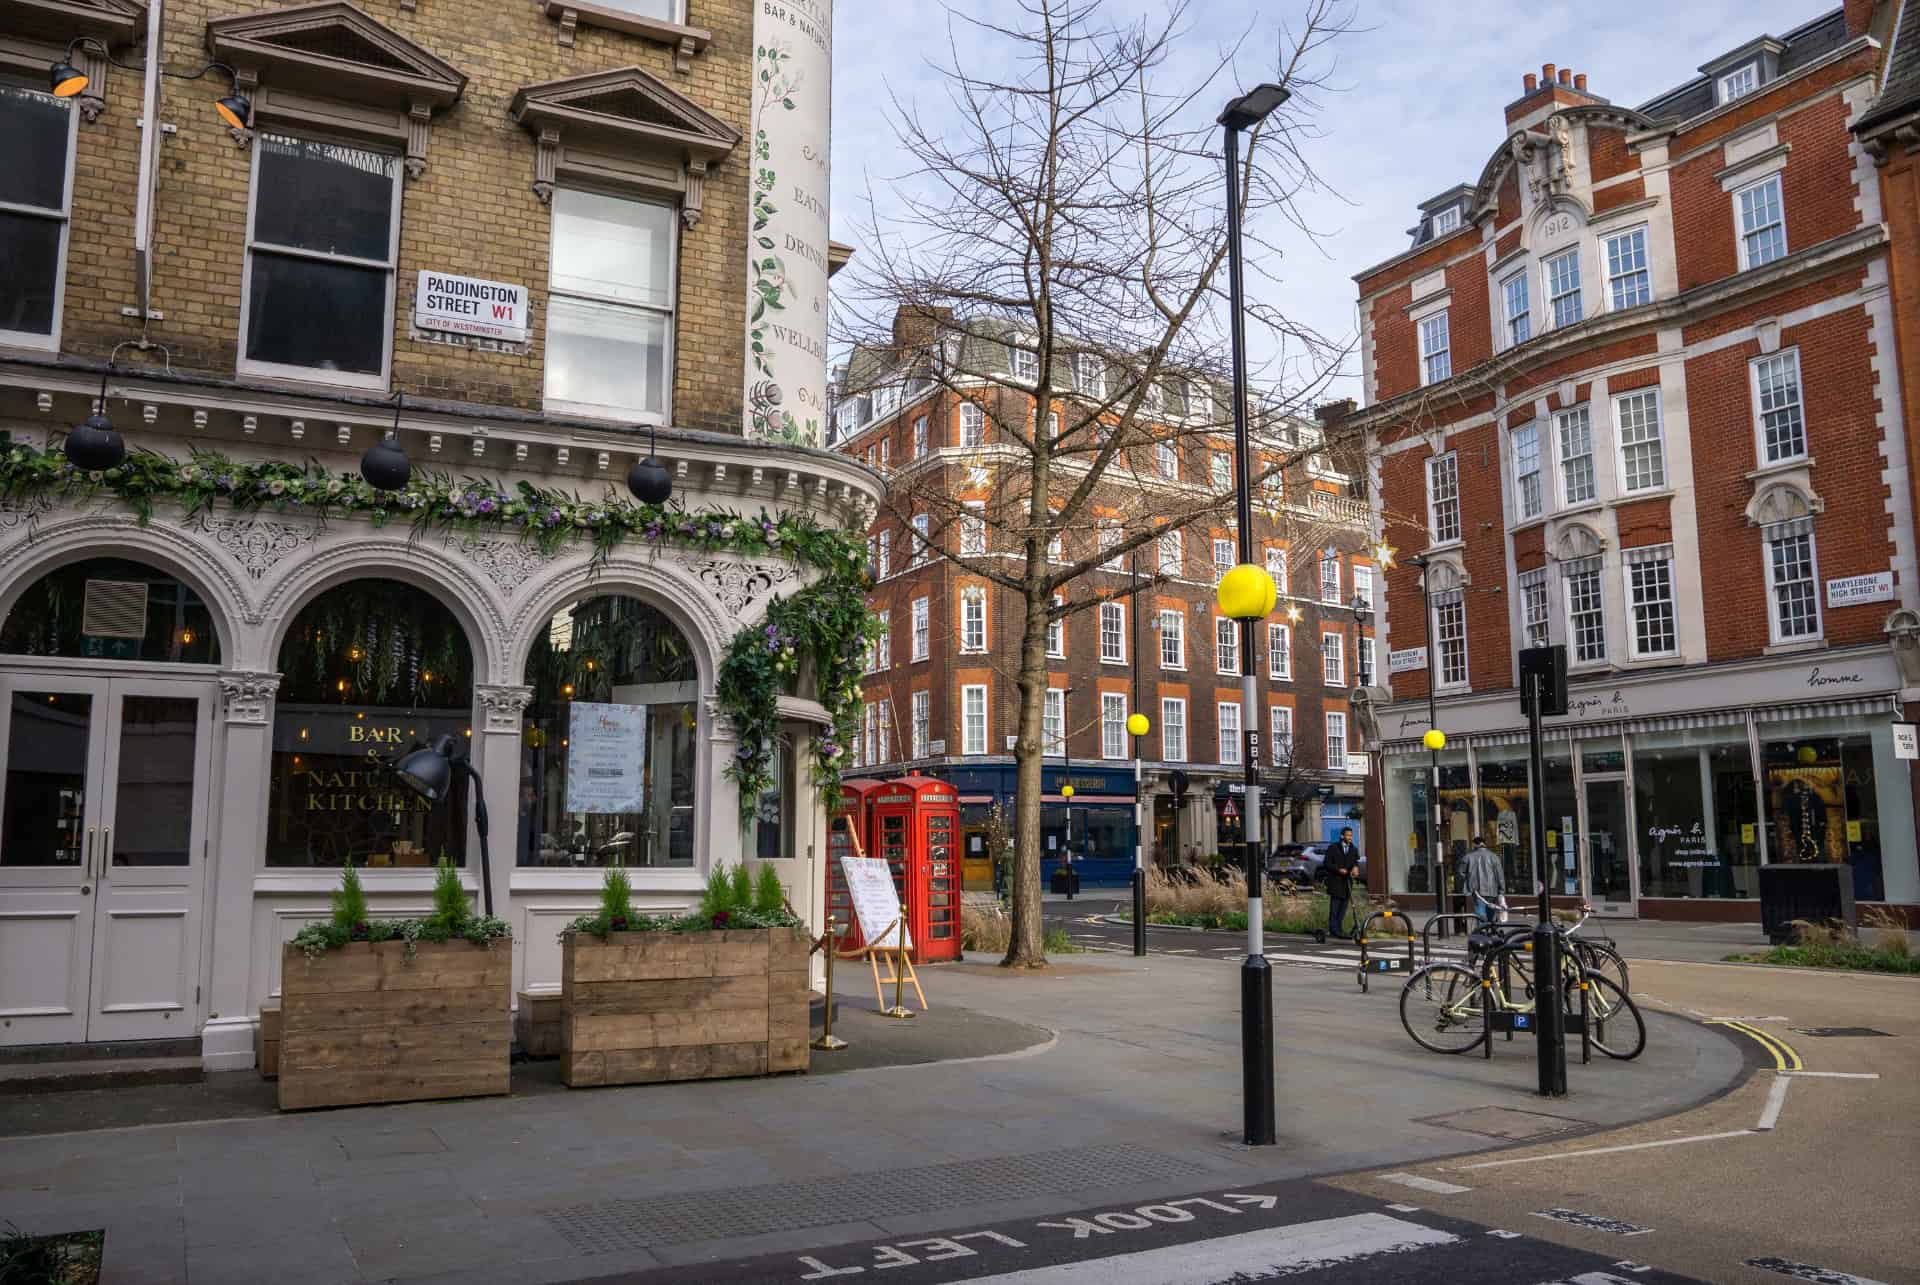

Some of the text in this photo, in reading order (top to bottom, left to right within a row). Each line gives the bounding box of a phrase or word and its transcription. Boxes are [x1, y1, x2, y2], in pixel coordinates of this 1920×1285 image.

[764, 2, 785, 21] BAR
[790, 14, 796, 26] &
[427, 277, 518, 304] PADDINGTON
[426, 294, 513, 321] STREET W1
[453, 321, 503, 336] WESTMINSTER
[1830, 576, 1880, 590] MARYLEBONE
[1831, 589, 1848, 599] HIGH
[1851, 585, 1876, 596] STREET
[1808, 667, 1864, 687] homme
[350, 726, 402, 743] BAR
[366, 749, 380, 764] &
[306, 793, 432, 812] KITCHEN
[798, 1197, 1244, 1280] LOOK LEFT
